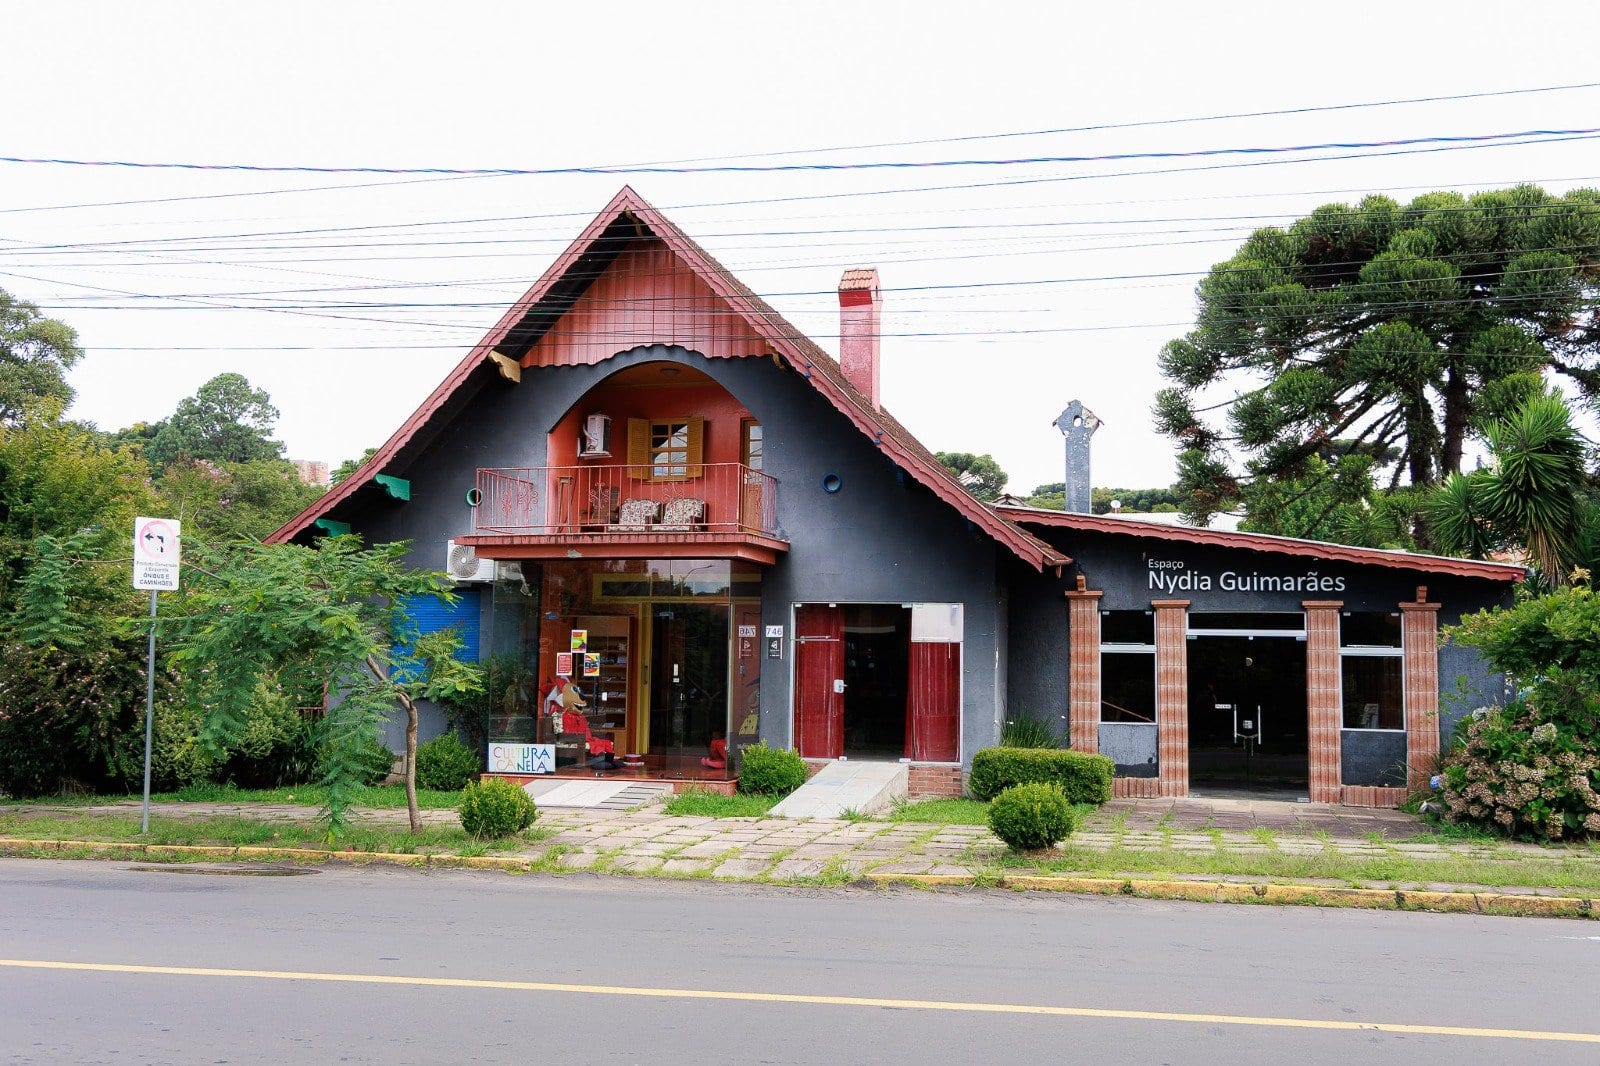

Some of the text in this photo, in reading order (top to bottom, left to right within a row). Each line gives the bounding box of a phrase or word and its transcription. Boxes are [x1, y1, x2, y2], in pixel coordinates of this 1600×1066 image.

[1148, 559, 1184, 570] Espaço
[1149, 570, 1346, 594] Nydia Guimarães
[766, 627, 782, 636] 746
[494, 746, 551, 760] CULTURA
[496, 760, 547, 772] CANELA
